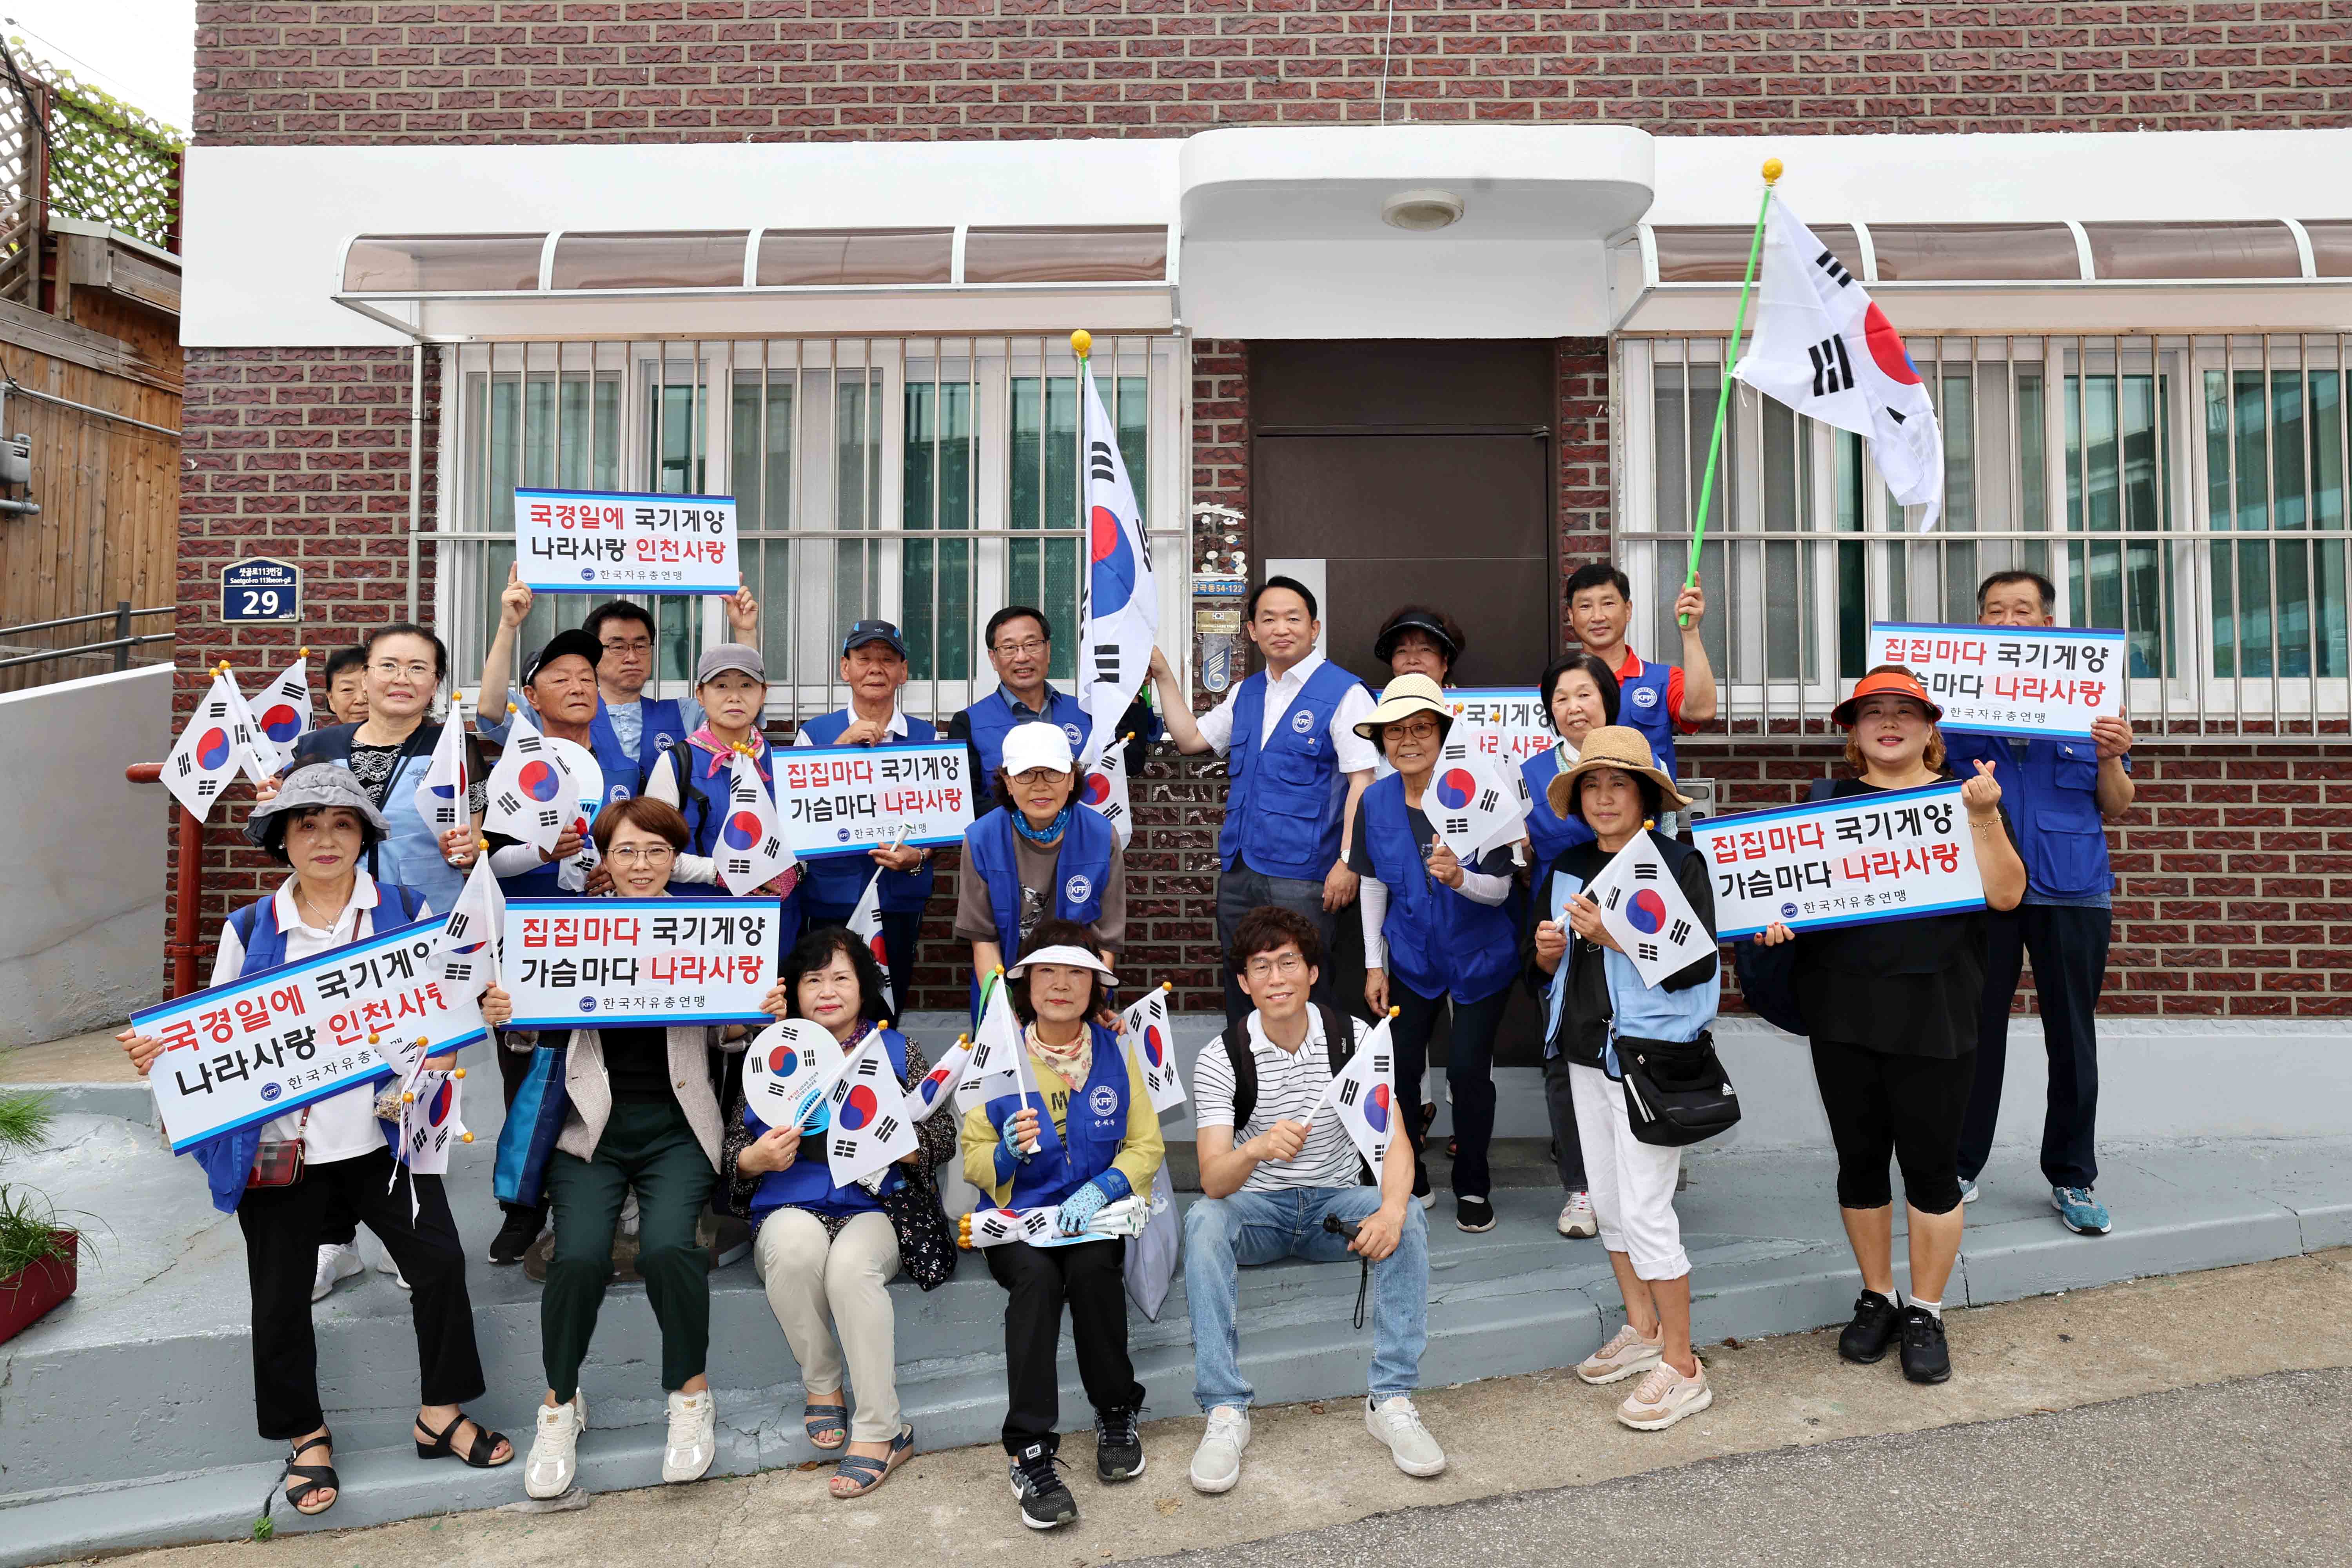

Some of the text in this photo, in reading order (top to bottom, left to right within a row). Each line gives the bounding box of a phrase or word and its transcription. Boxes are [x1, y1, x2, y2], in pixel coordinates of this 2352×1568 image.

[530, 504, 725, 534] 국경일에 국기게양
[532, 537, 726, 564] 나라사랑 인천사랑
[600, 570, 682, 581] 한국자유총연맹
[242, 591, 278, 614] 29
[1885, 638, 2109, 673] 집집마다 국기게양
[1995, 676, 2106, 707] 나라사랑
[1950, 707, 2046, 723] 한국자유총연맹
[788, 756, 959, 789] 집집마다 국기게양
[791, 788, 962, 823] 가슴마다 나라사랑
[1711, 803, 1953, 864] 집집마다 국기게양
[1719, 842, 1960, 900] 가슴마다 나라사랑
[1803, 889, 1906, 913] 한국자유총연맹
[523, 916, 765, 947] 집집마다 국기게양
[521, 955, 763, 987] 가슴마다 나라사랑
[603, 995, 705, 1009] 한국자유총연맹
[161, 984, 306, 1052] 국경일에
[175, 1025, 317, 1096] 나라사랑
[264, 1038, 403, 1097] KFF 한국자유총
[1095, 1097, 1112, 1106] KFF
[1029, 1446, 1038, 1455] NIKE
